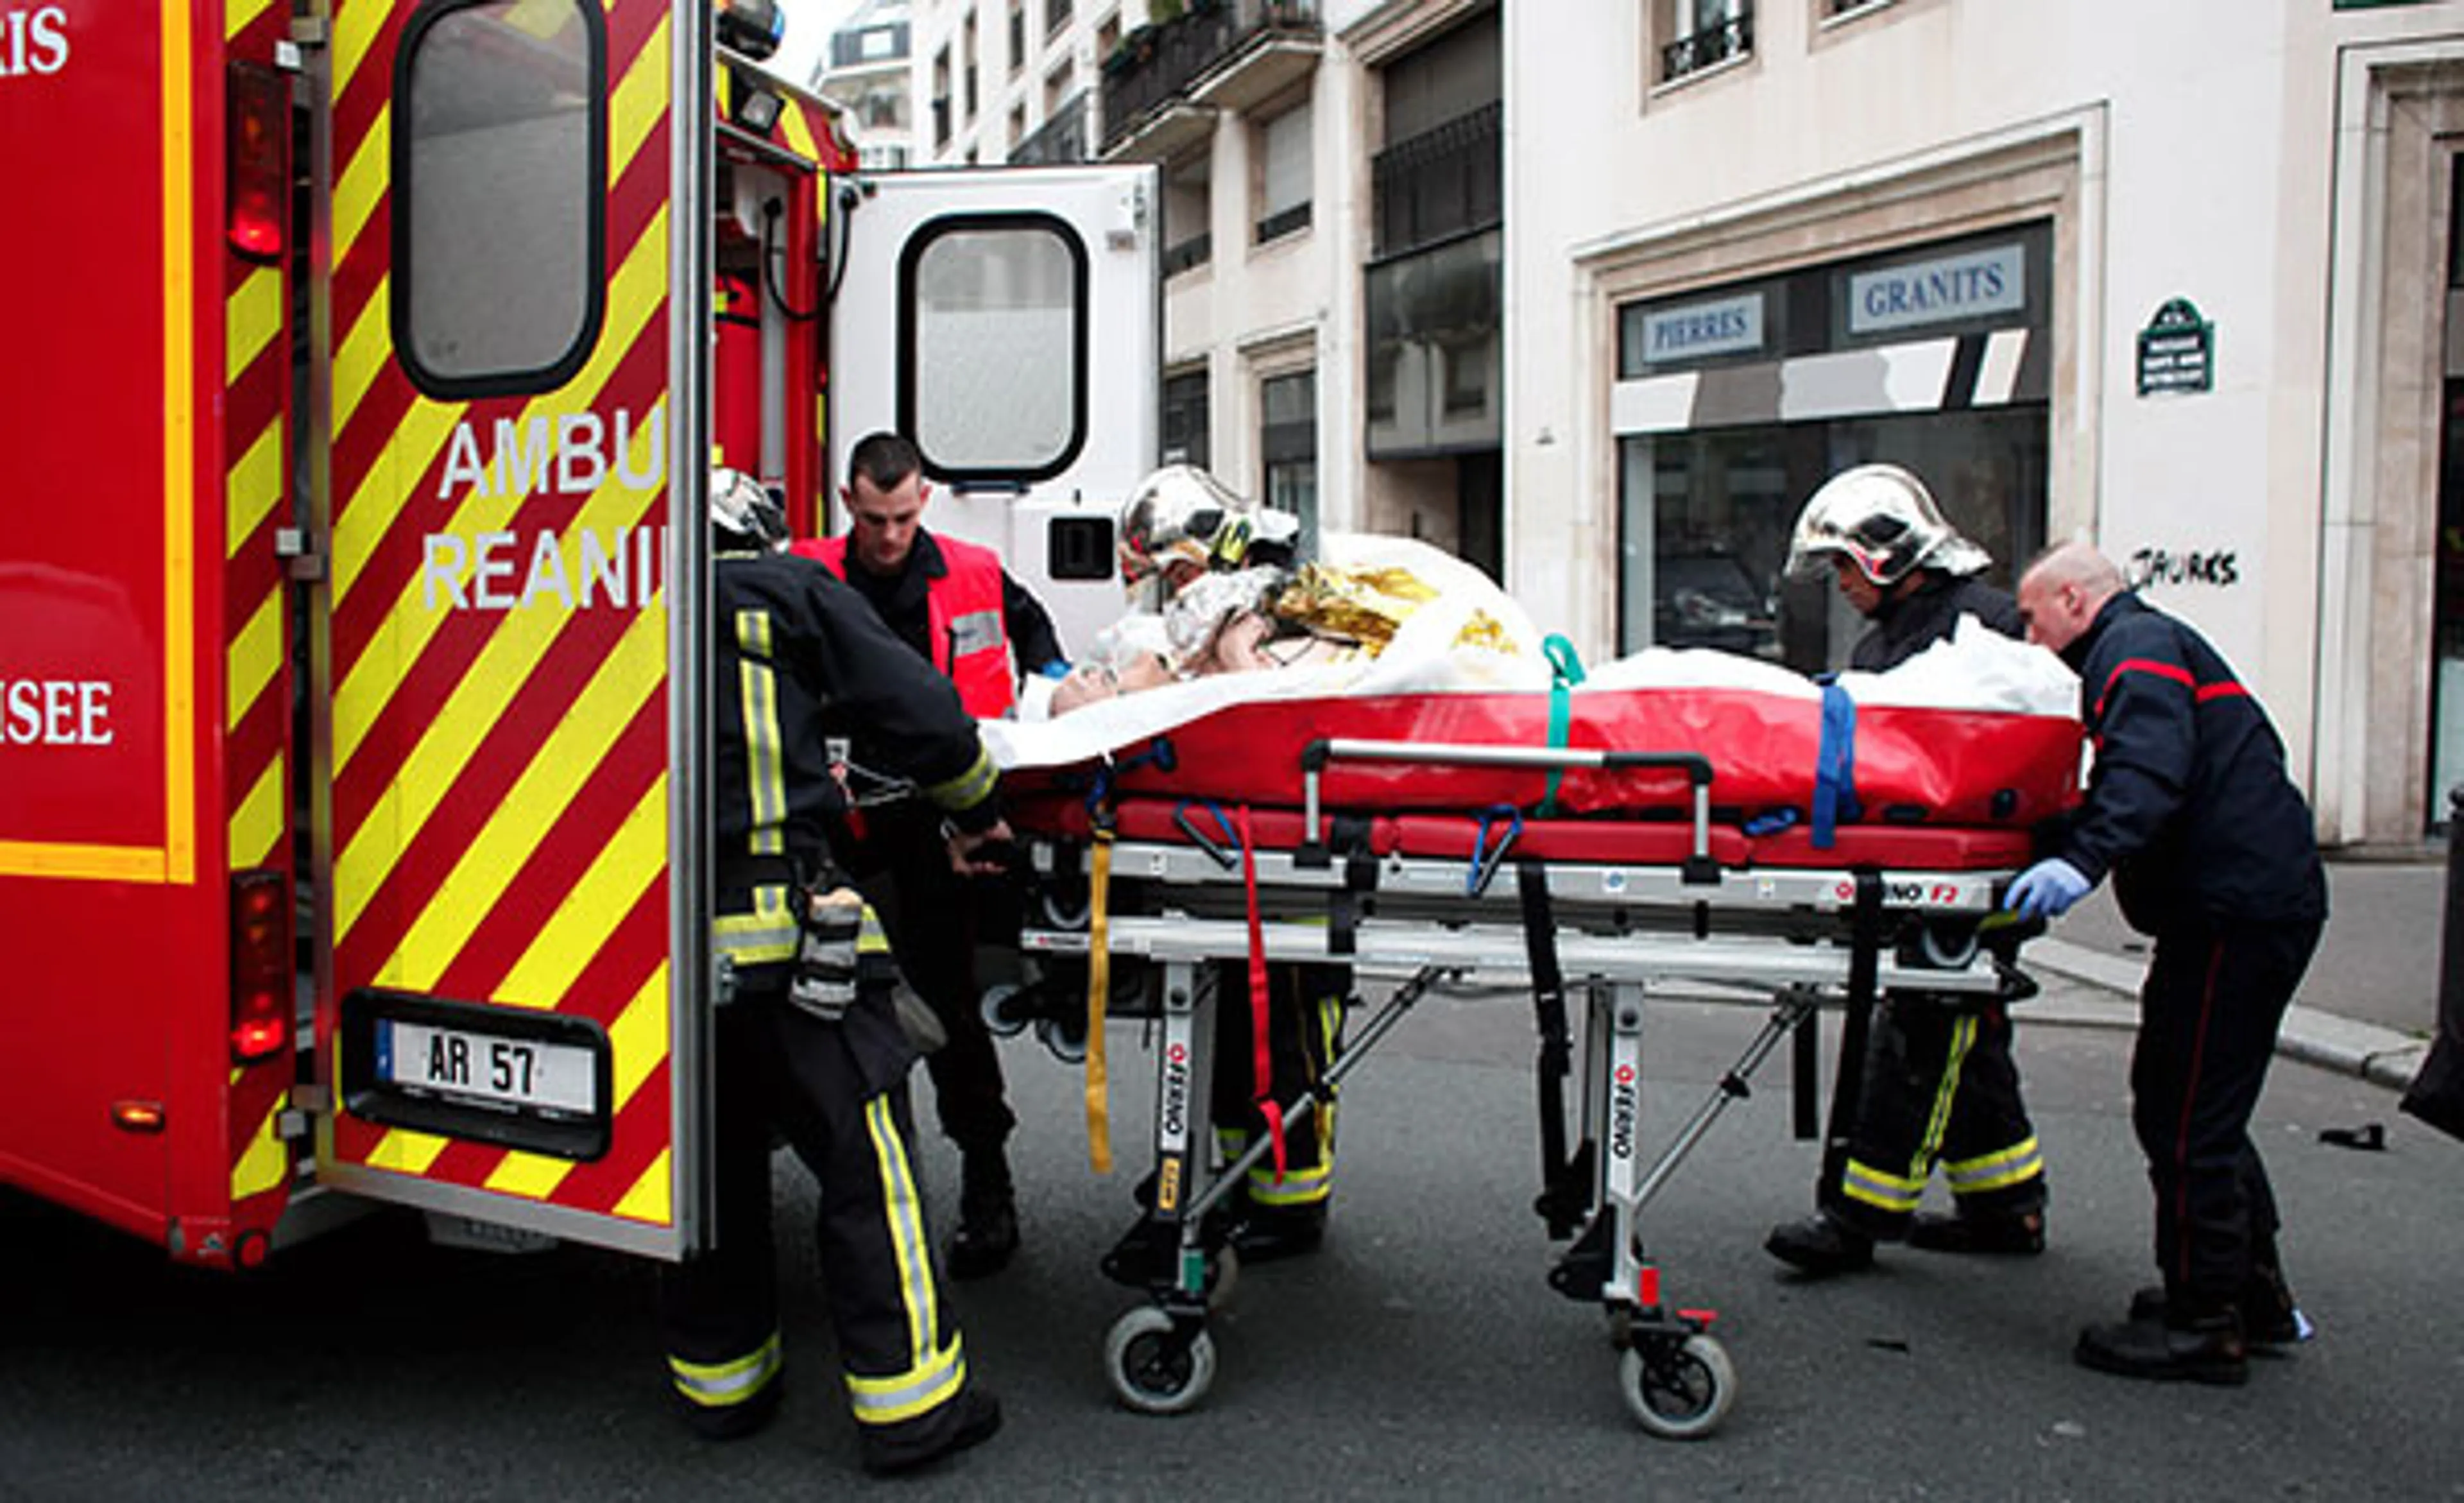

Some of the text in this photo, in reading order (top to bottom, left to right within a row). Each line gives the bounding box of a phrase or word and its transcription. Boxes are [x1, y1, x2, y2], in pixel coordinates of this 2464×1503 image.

[0, 6, 69, 76] IS
[1865, 262, 2004, 317] GRANITS
[1654, 307, 1747, 350] PIERRES
[438, 407, 666, 499] AMBU
[423, 526, 669, 609] REANI
[0, 679, 113, 745] SEE
[427, 1035, 533, 1095] AR 57
[1165, 1063, 1187, 1135] FERNO
[1613, 1085, 1636, 1159] FERNO
